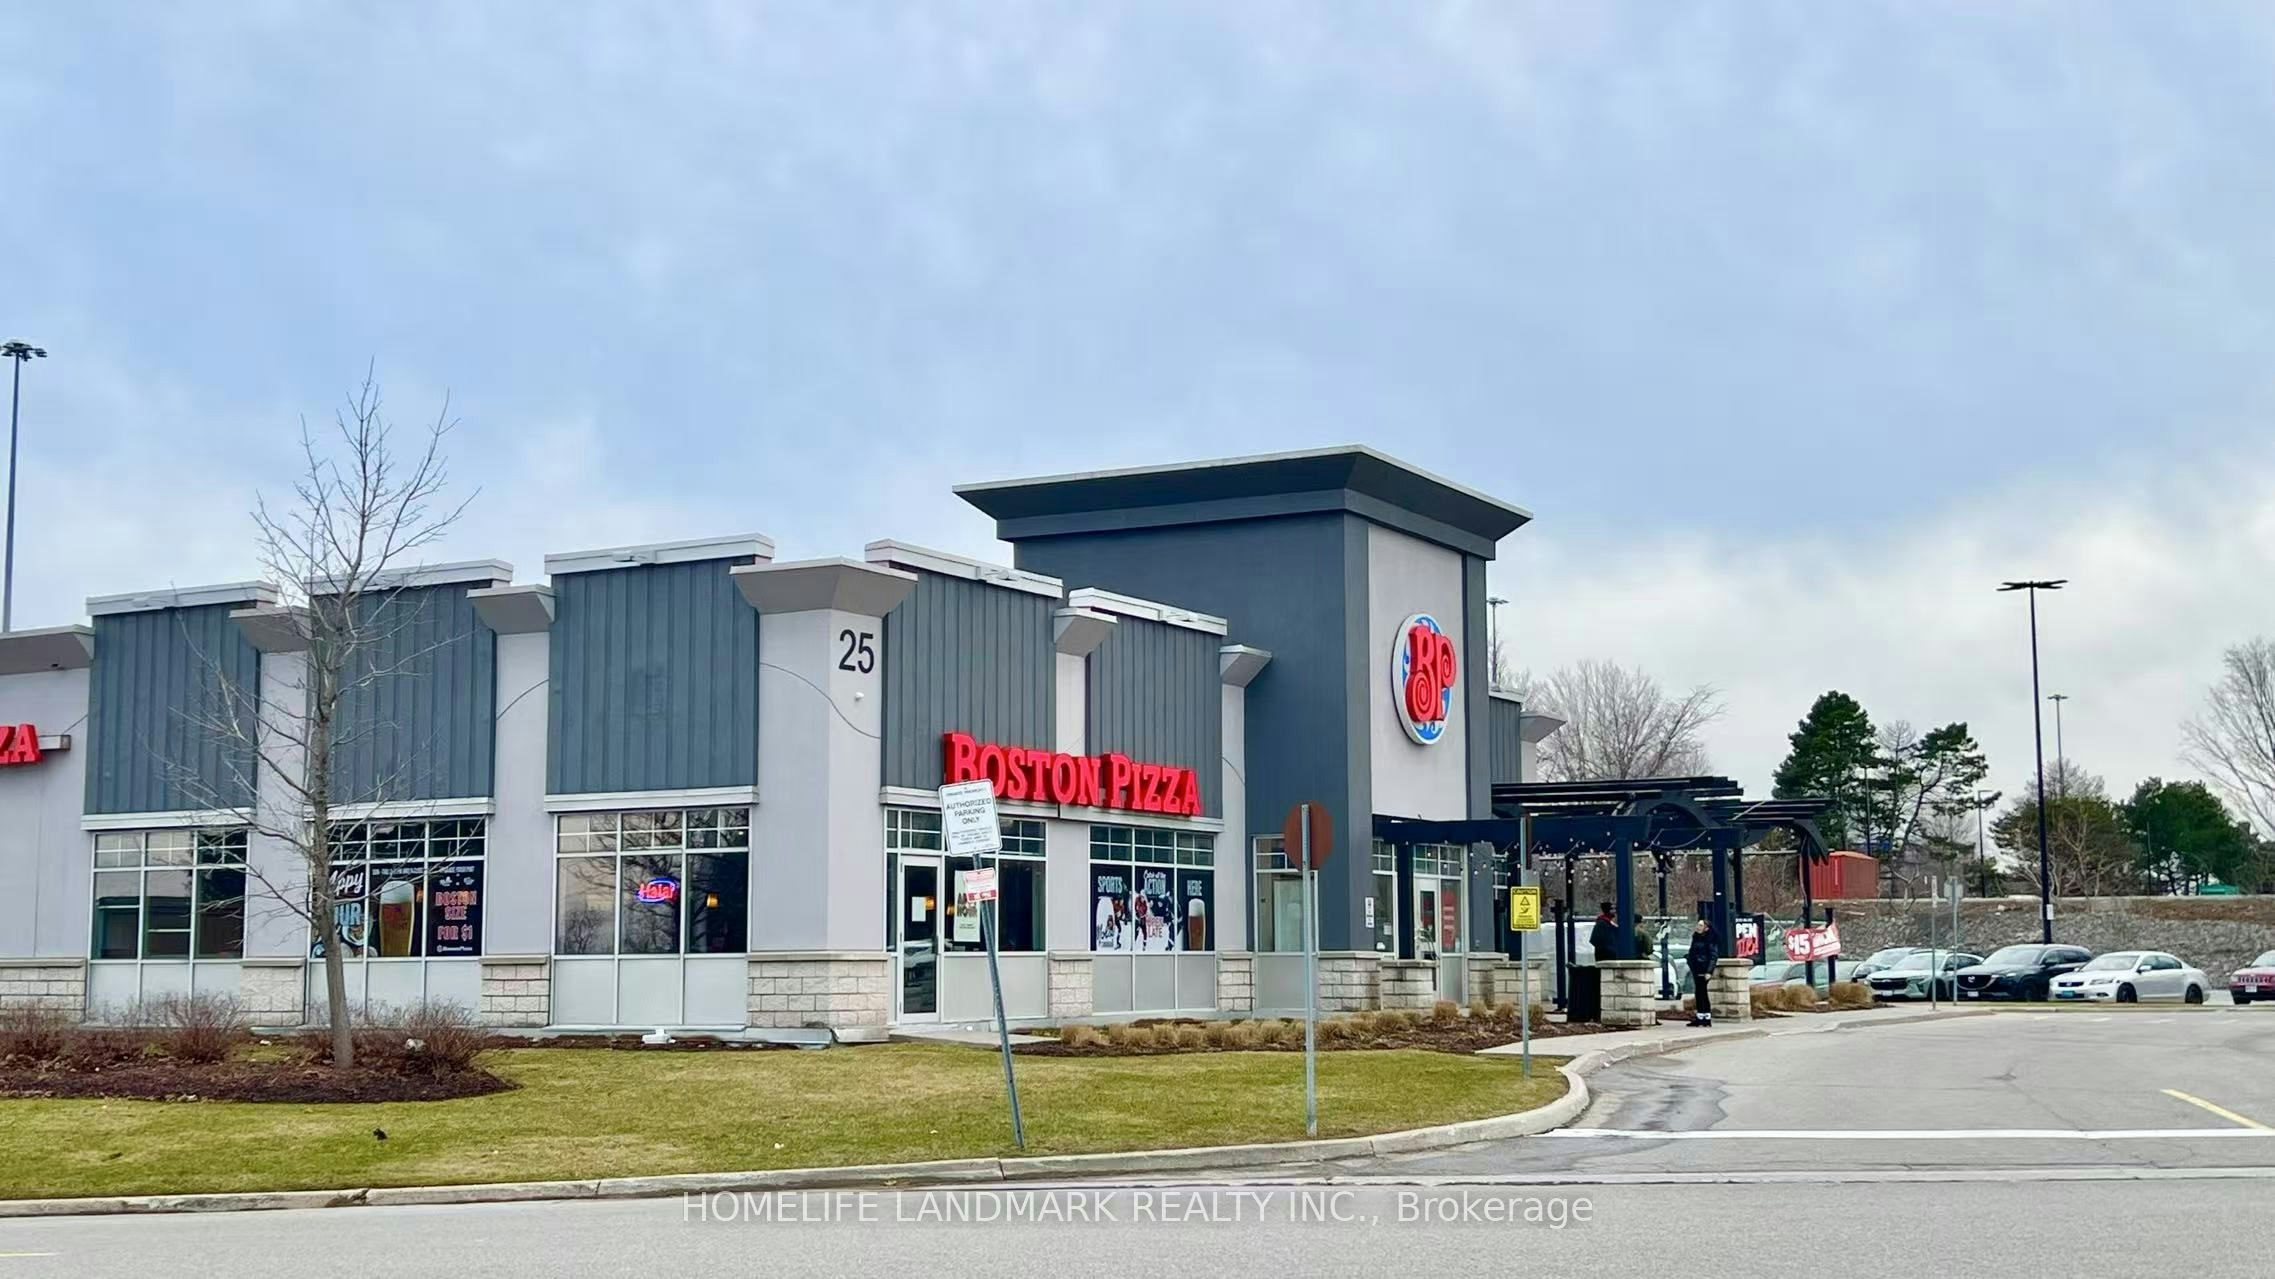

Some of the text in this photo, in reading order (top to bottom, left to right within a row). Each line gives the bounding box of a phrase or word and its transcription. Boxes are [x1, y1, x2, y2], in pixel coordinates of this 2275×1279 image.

[839, 629, 874, 673] 25
[1405, 625, 1456, 721] BP
[944, 732, 1202, 817] BOSTON PIZZA
[946, 798, 991, 809] AUTHORIZED
[954, 807, 985, 816] PARKING
[962, 816, 980, 825] ONLY
[1097, 876, 1123, 894] SPORTS
[435, 890, 478, 906] BOSTON
[437, 923, 473, 942] FOR $1
[1735, 922, 1758, 938] PEN
[1787, 933, 1811, 955] $15
